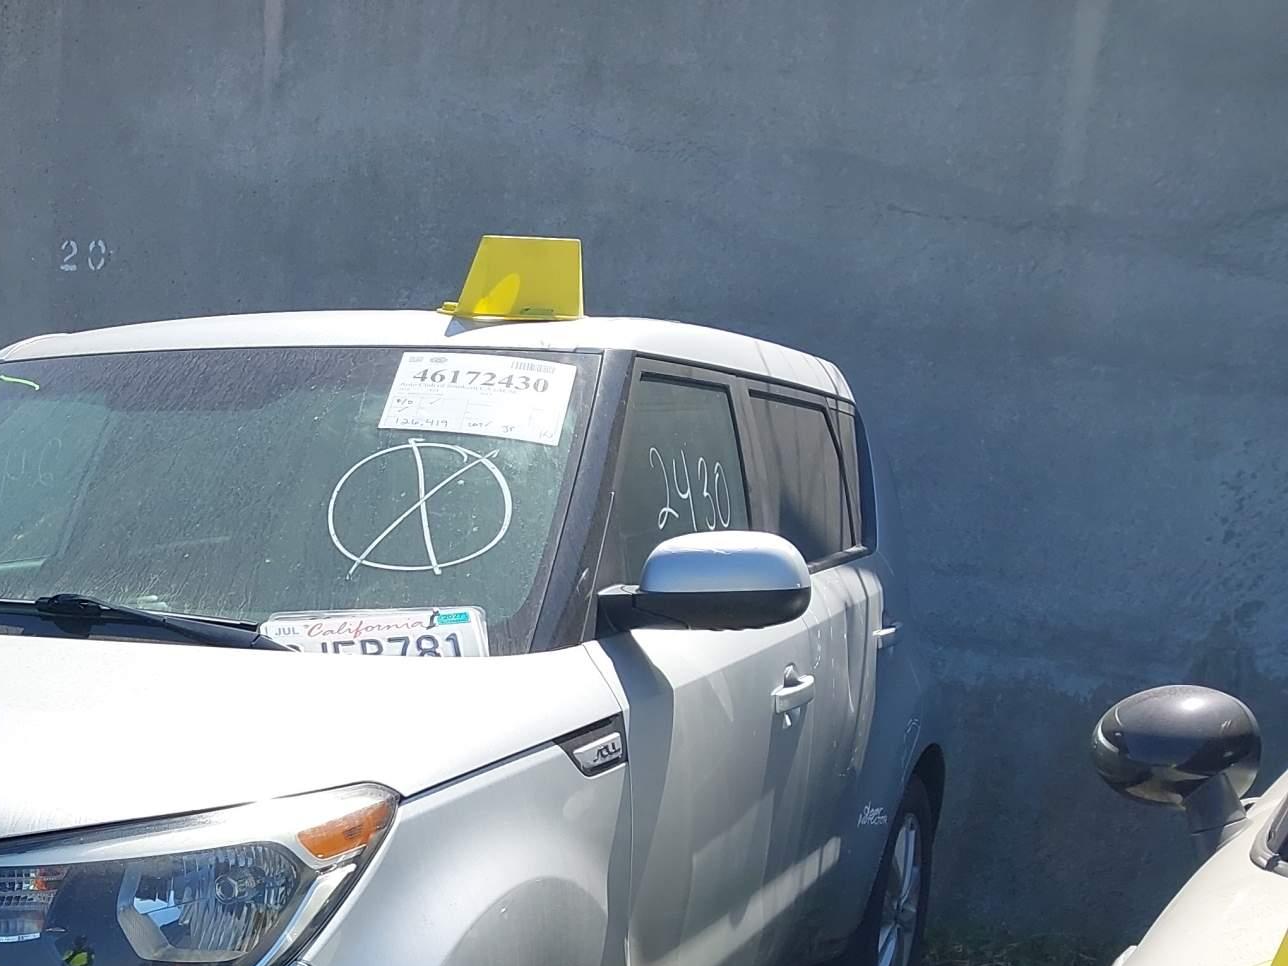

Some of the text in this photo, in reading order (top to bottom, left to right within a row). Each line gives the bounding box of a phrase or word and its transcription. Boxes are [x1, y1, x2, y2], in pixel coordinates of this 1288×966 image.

[59, 239, 107, 272] 20
[412, 367, 549, 393] 46172430
[649, 441, 731, 532] 2430
[274, 619, 426, 640] JUL California
